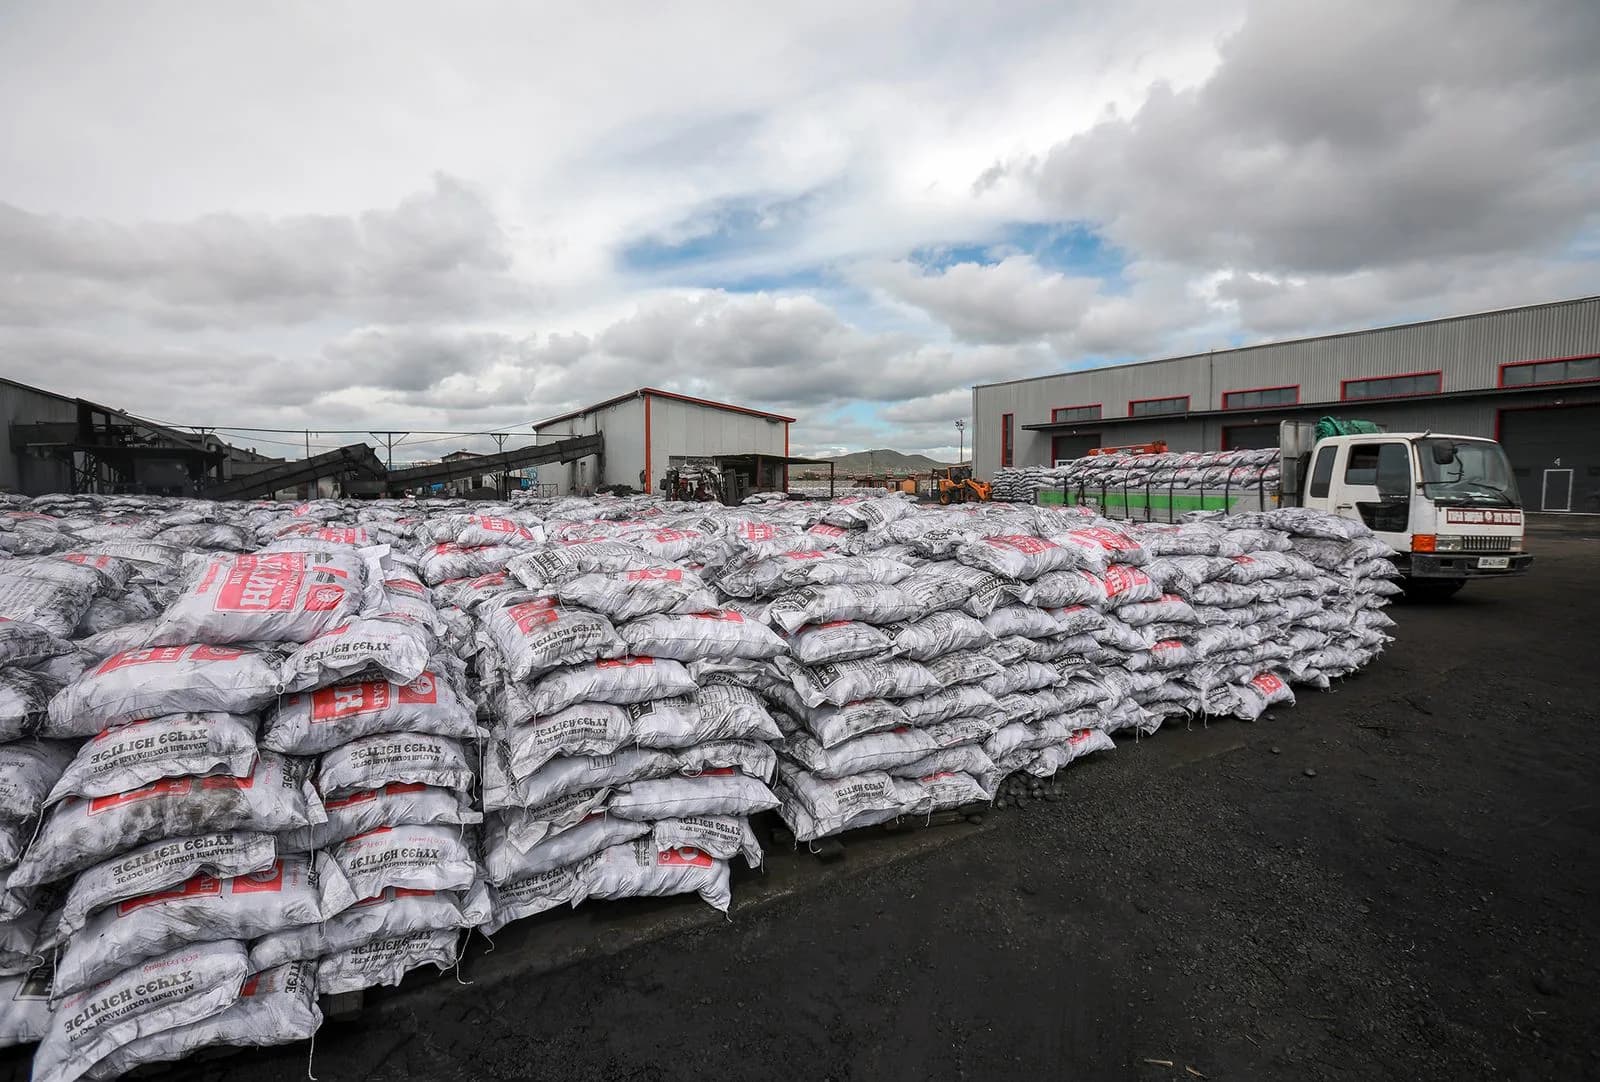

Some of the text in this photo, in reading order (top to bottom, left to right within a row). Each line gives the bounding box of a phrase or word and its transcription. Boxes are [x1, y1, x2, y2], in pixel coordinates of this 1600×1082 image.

[352, 641, 391, 651] ХҮЧЭЭ
[158, 729, 209, 744] ХҮЧЭЭ
[90, 737, 154, 764] НЭГТГЭЕ
[350, 743, 442, 761] ХҮЧЭЭ НЭГТГЭЕ
[112, 834, 235, 876] ХҮЧЭЭ НЭГТГЭЕ
[401, 847, 439, 859] ХҮЧЭЭ
[145, 971, 194, 994] ХҮЧЭЭ
[152, 984, 195, 1004] АГААРЫН
[64, 986, 136, 1034] НЭГТГЭЕ
